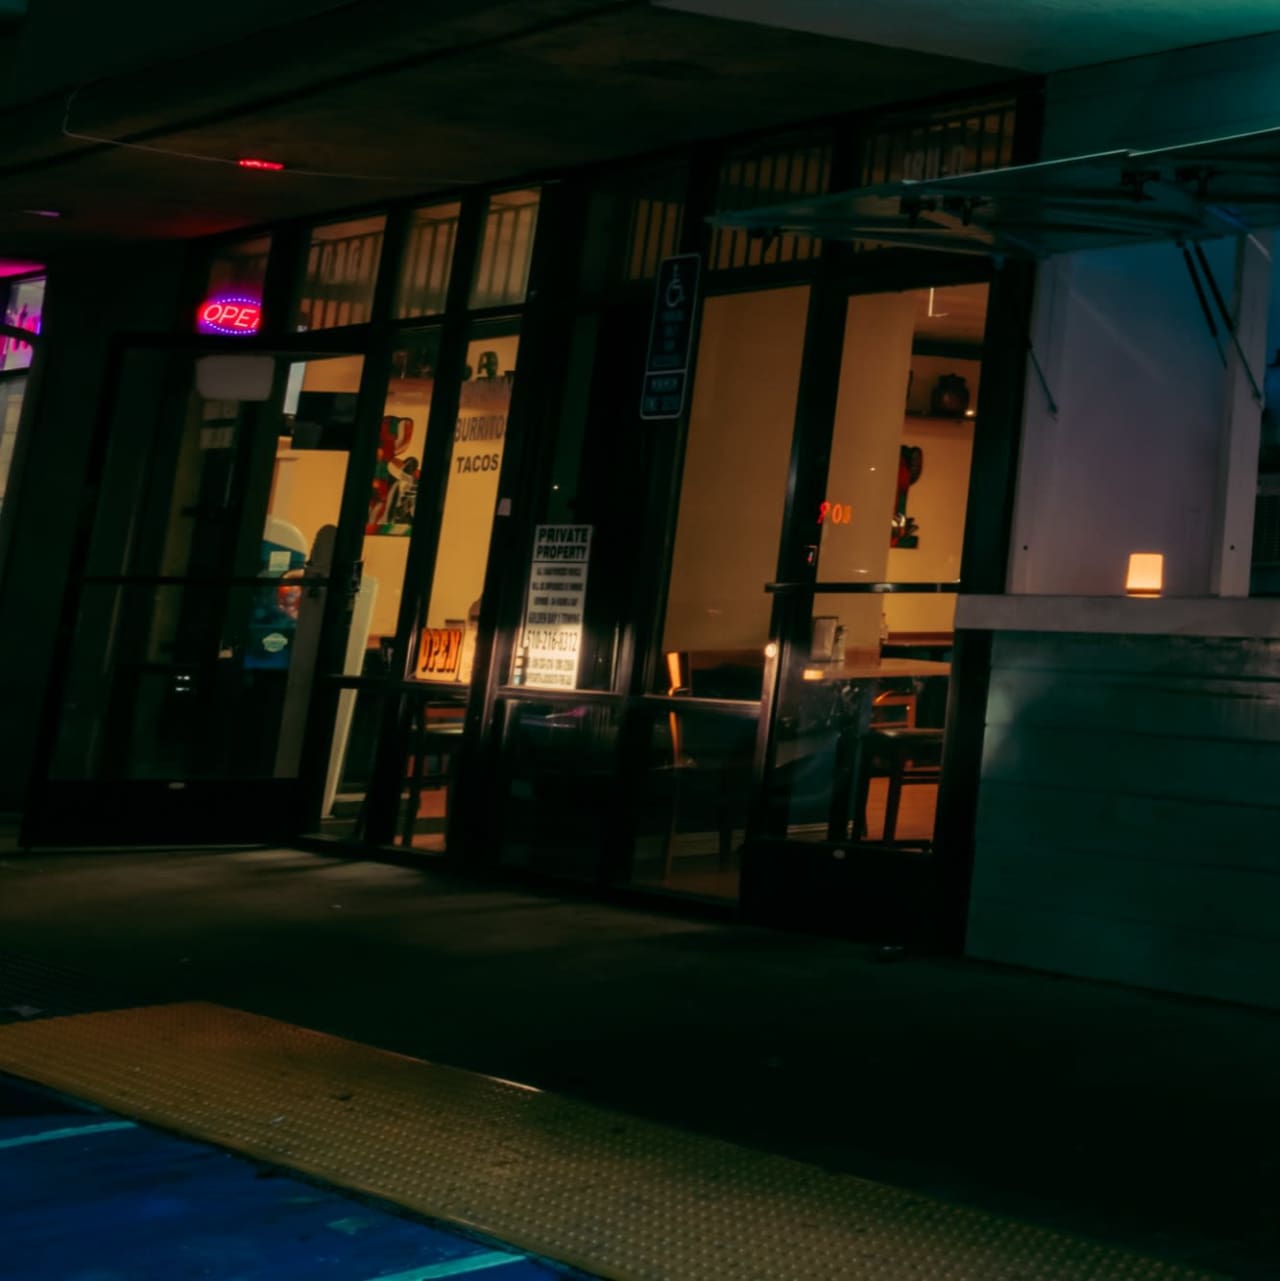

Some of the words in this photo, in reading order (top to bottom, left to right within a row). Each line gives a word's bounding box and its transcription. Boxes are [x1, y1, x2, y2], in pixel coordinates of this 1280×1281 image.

[454, 415, 508, 442] BURRITO
[456, 453, 500, 473] TACOS
[538, 527, 589, 544] PRIVATE
[536, 544, 587, 560] PROPERTY
[421, 628, 466, 682] OPEN
